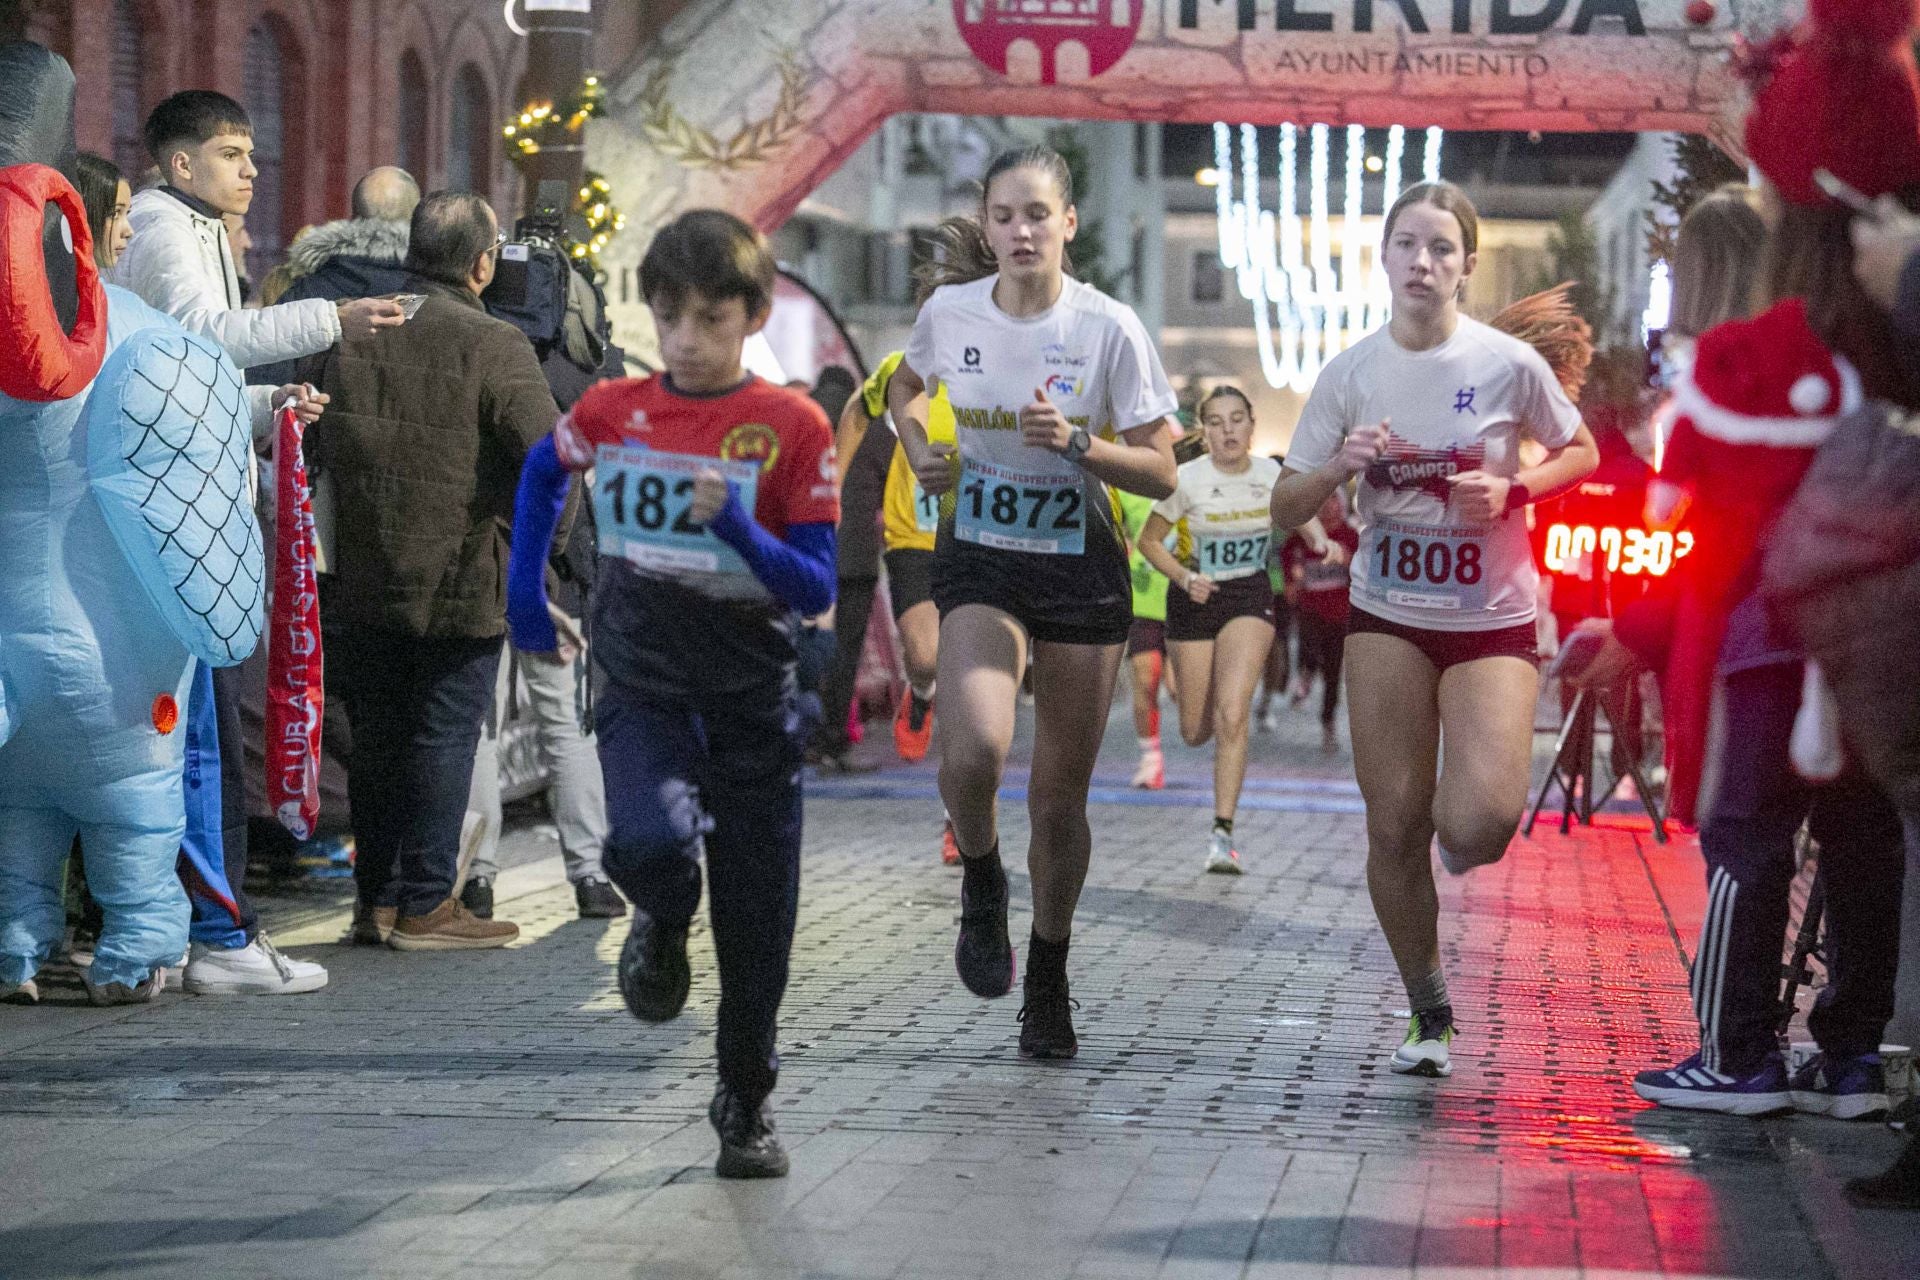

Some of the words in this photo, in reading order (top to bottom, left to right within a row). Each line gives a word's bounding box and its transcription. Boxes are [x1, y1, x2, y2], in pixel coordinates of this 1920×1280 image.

[1274, 49, 1549, 77] AYUNTAMIENTO
[603, 469, 705, 536] 182
[964, 478, 1081, 529] 1872
[1205, 535, 1269, 566] 1827
[1376, 535, 1482, 585] 1808
